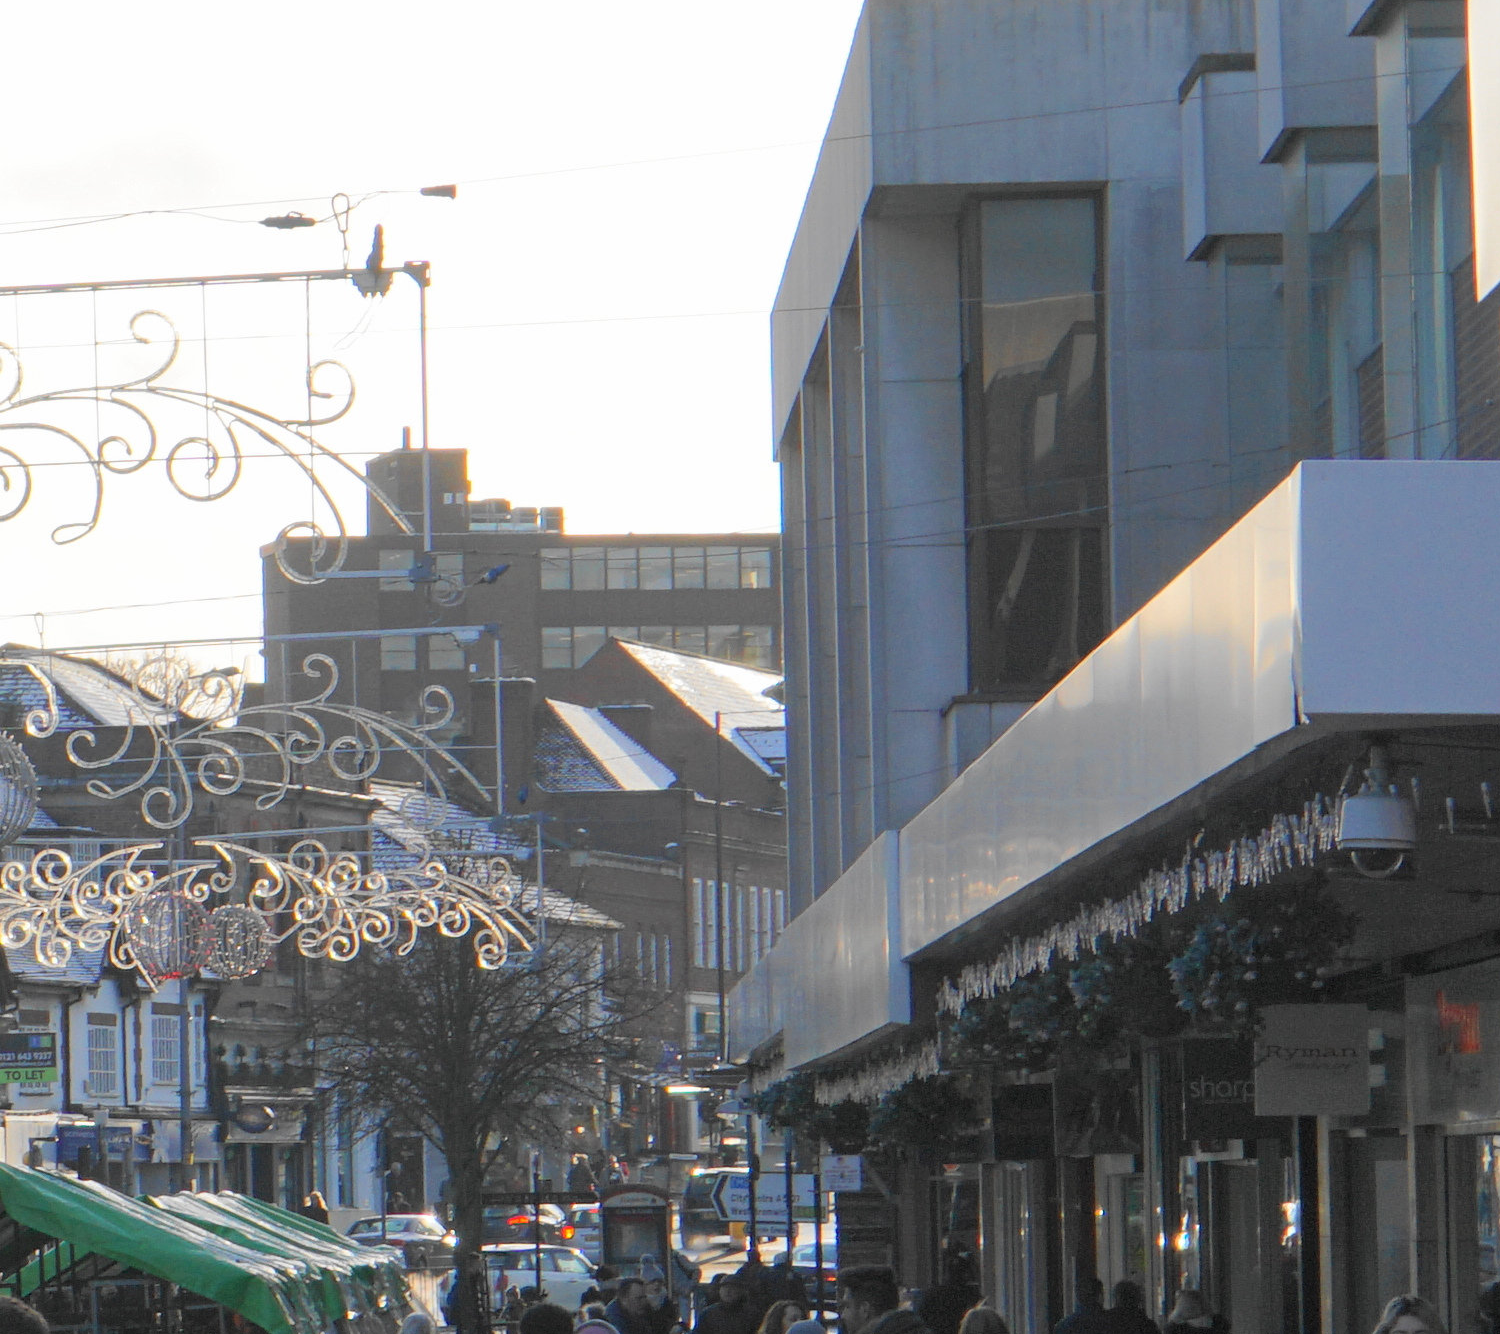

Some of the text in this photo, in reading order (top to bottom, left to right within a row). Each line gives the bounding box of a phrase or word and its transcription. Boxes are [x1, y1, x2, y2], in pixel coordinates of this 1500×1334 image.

[1267, 1045, 1358, 1060] Ryman
[4, 1069, 46, 1081] TO LET
